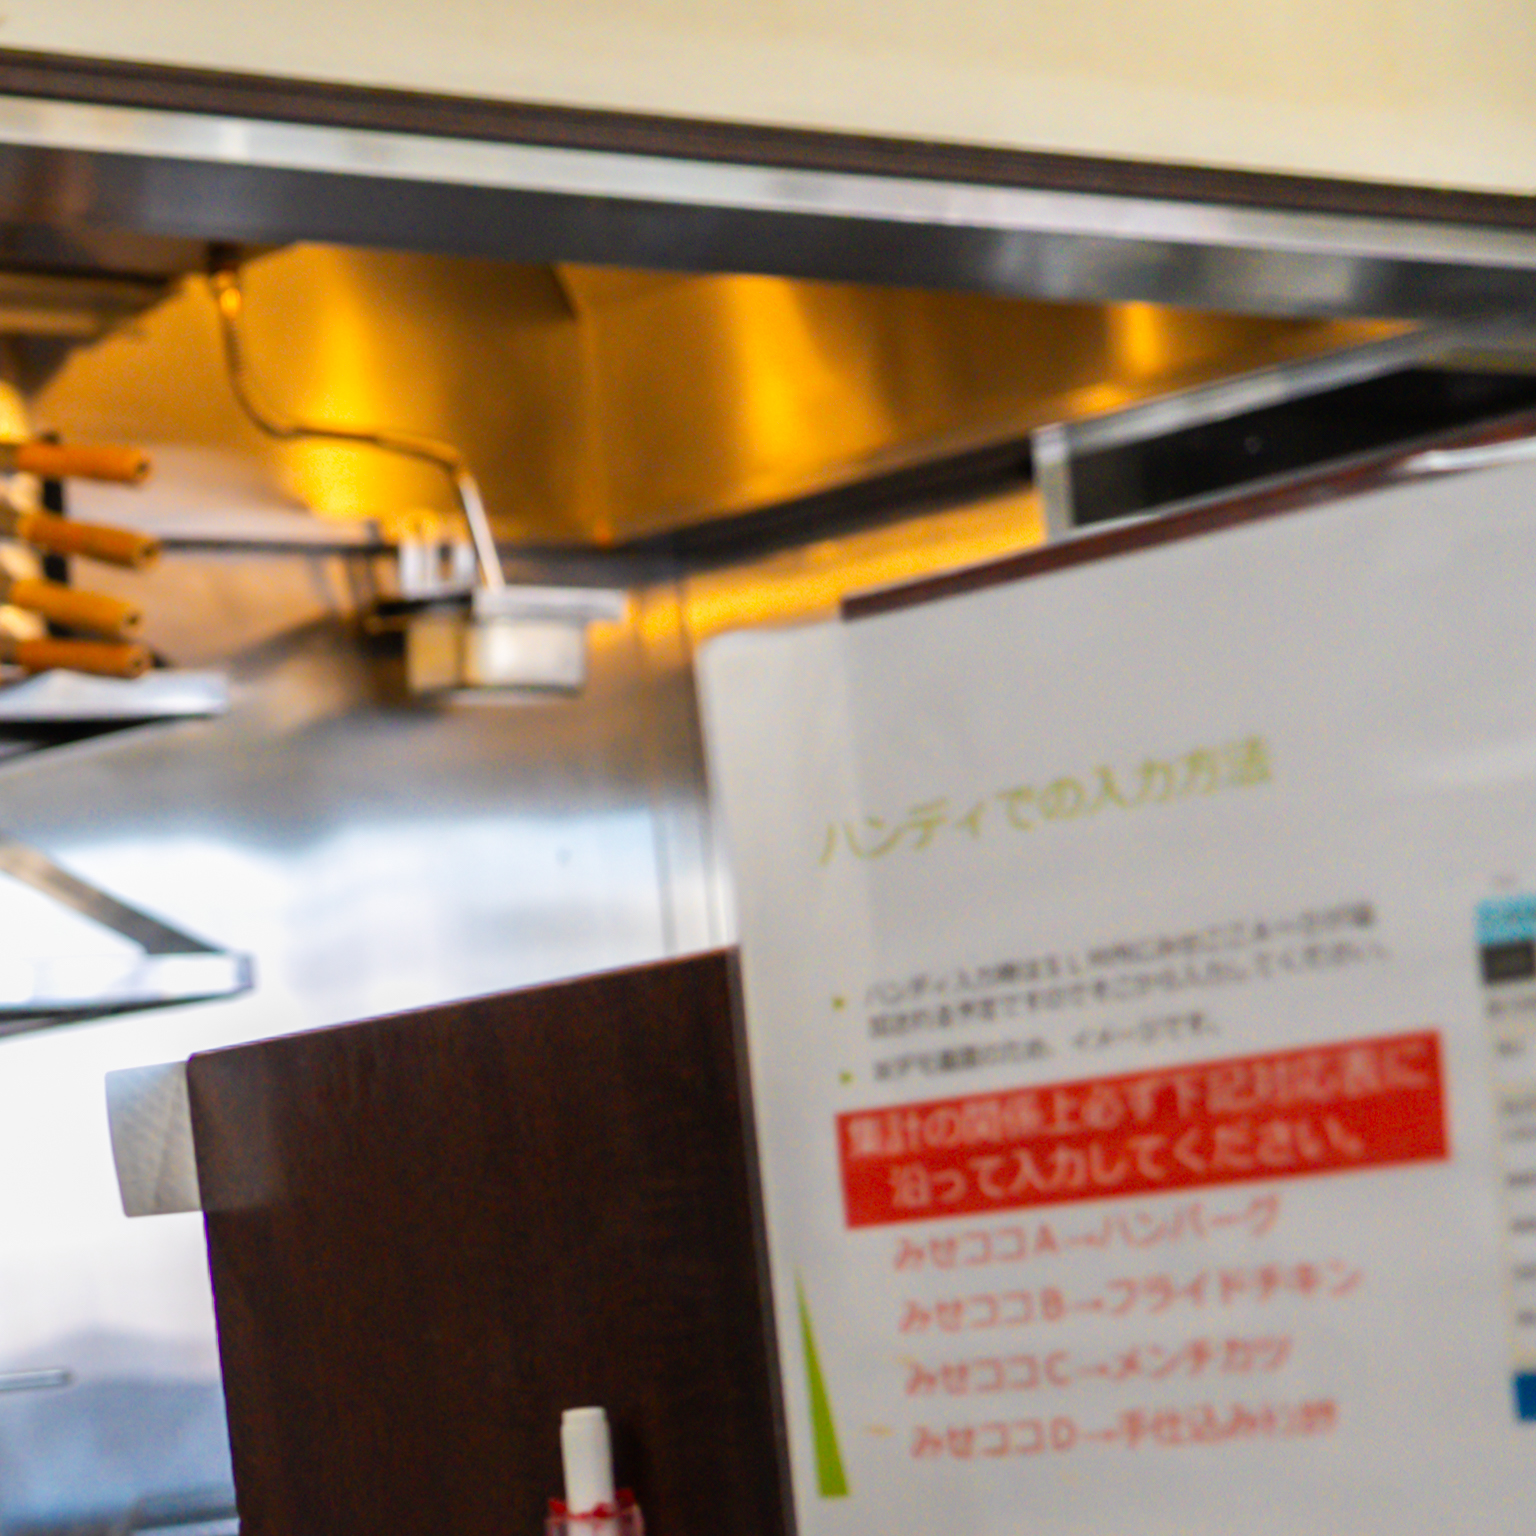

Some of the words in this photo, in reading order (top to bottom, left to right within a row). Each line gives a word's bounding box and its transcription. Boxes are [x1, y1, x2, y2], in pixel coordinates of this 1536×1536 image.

[818, 734, 1275, 866] ハンディでの入力方法
